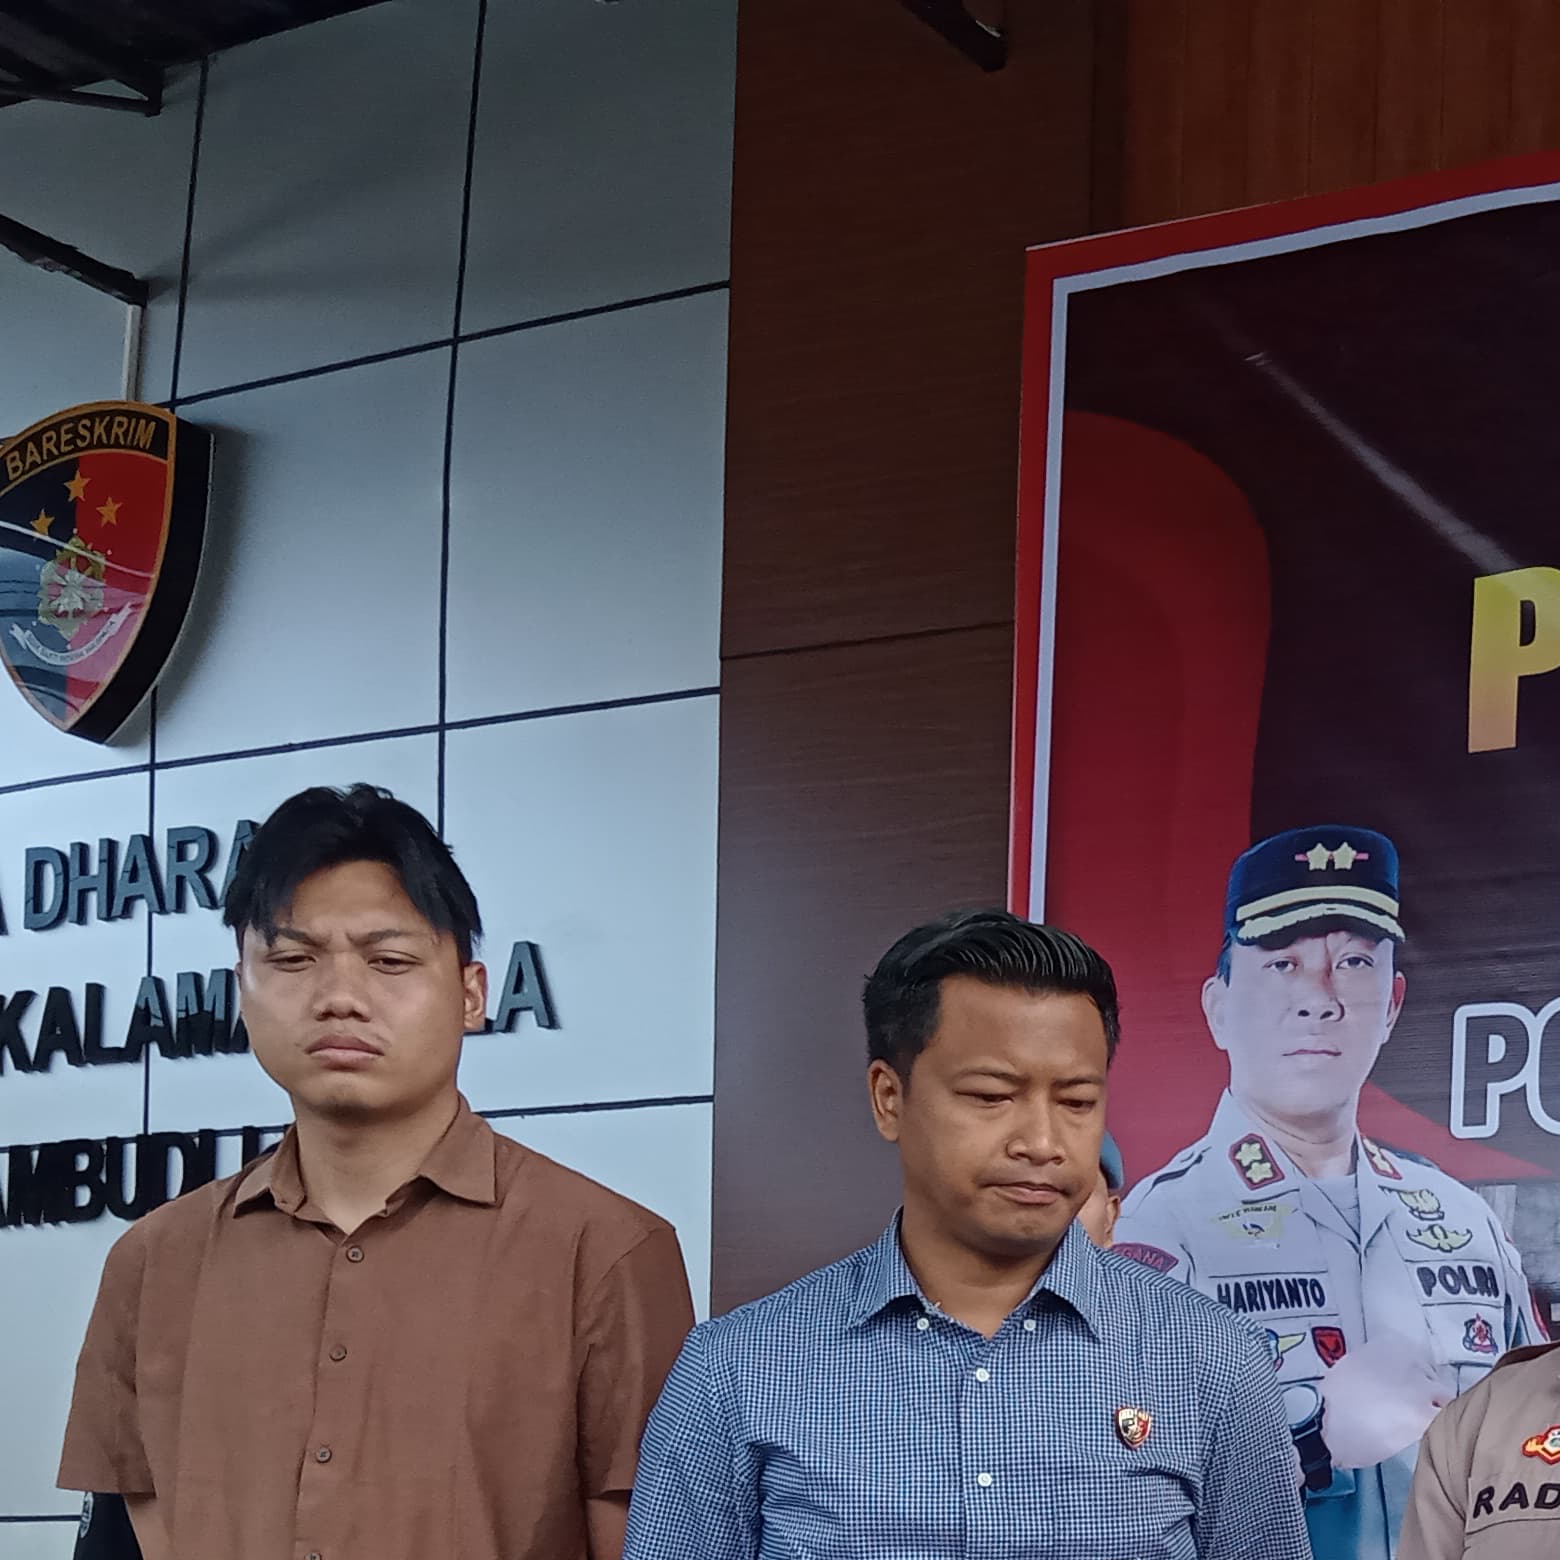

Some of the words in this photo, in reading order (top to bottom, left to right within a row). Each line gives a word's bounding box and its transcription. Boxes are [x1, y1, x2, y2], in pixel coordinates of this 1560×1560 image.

[5, 415, 157, 481] BARESKRIM
[1216, 1278, 1326, 1313] HARIYANTO
[1416, 1265, 1500, 1299] POLRI
